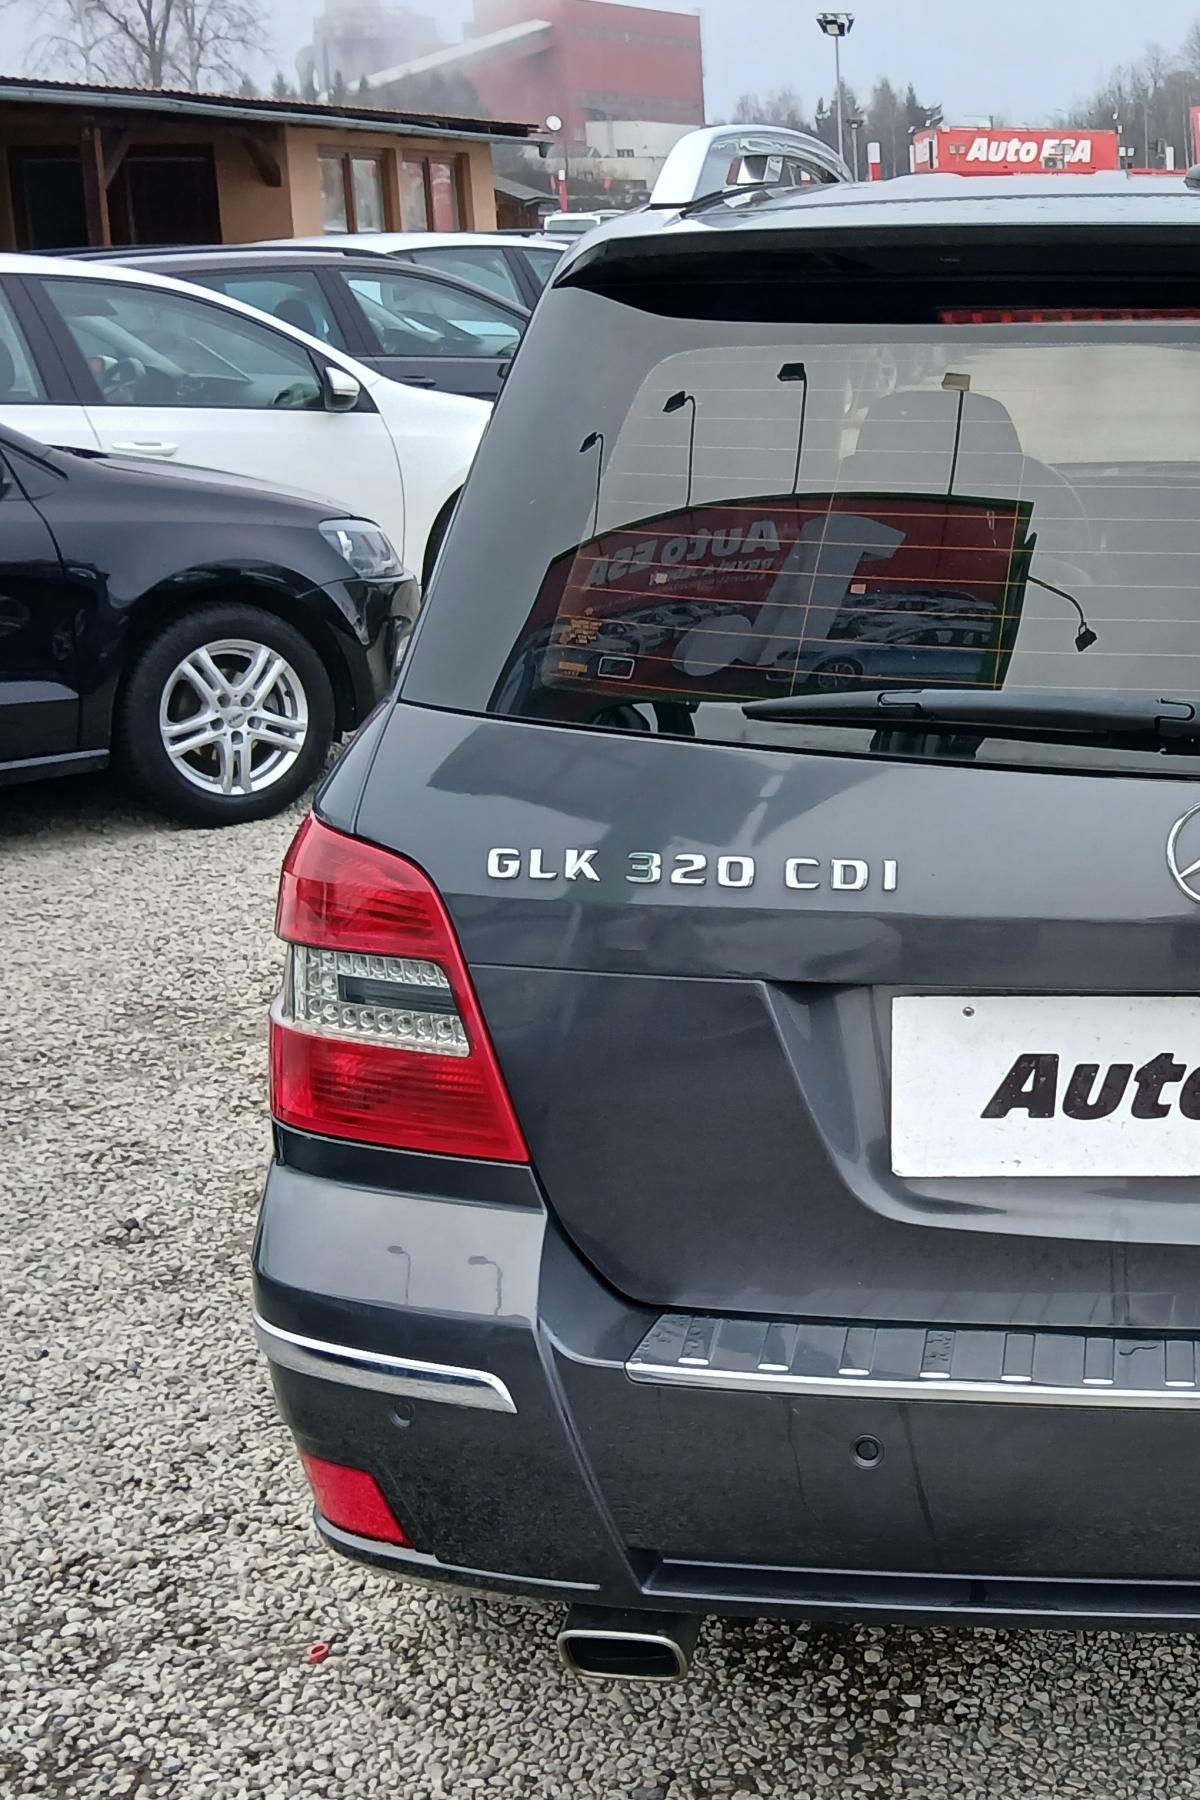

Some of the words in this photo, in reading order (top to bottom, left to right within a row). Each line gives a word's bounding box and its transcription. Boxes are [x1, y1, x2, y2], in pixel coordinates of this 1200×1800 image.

[965, 137, 1039, 163] Auto
[487, 847, 601, 882] GLK
[625, 851, 756, 888] 320
[785, 857, 899, 891] CDI
